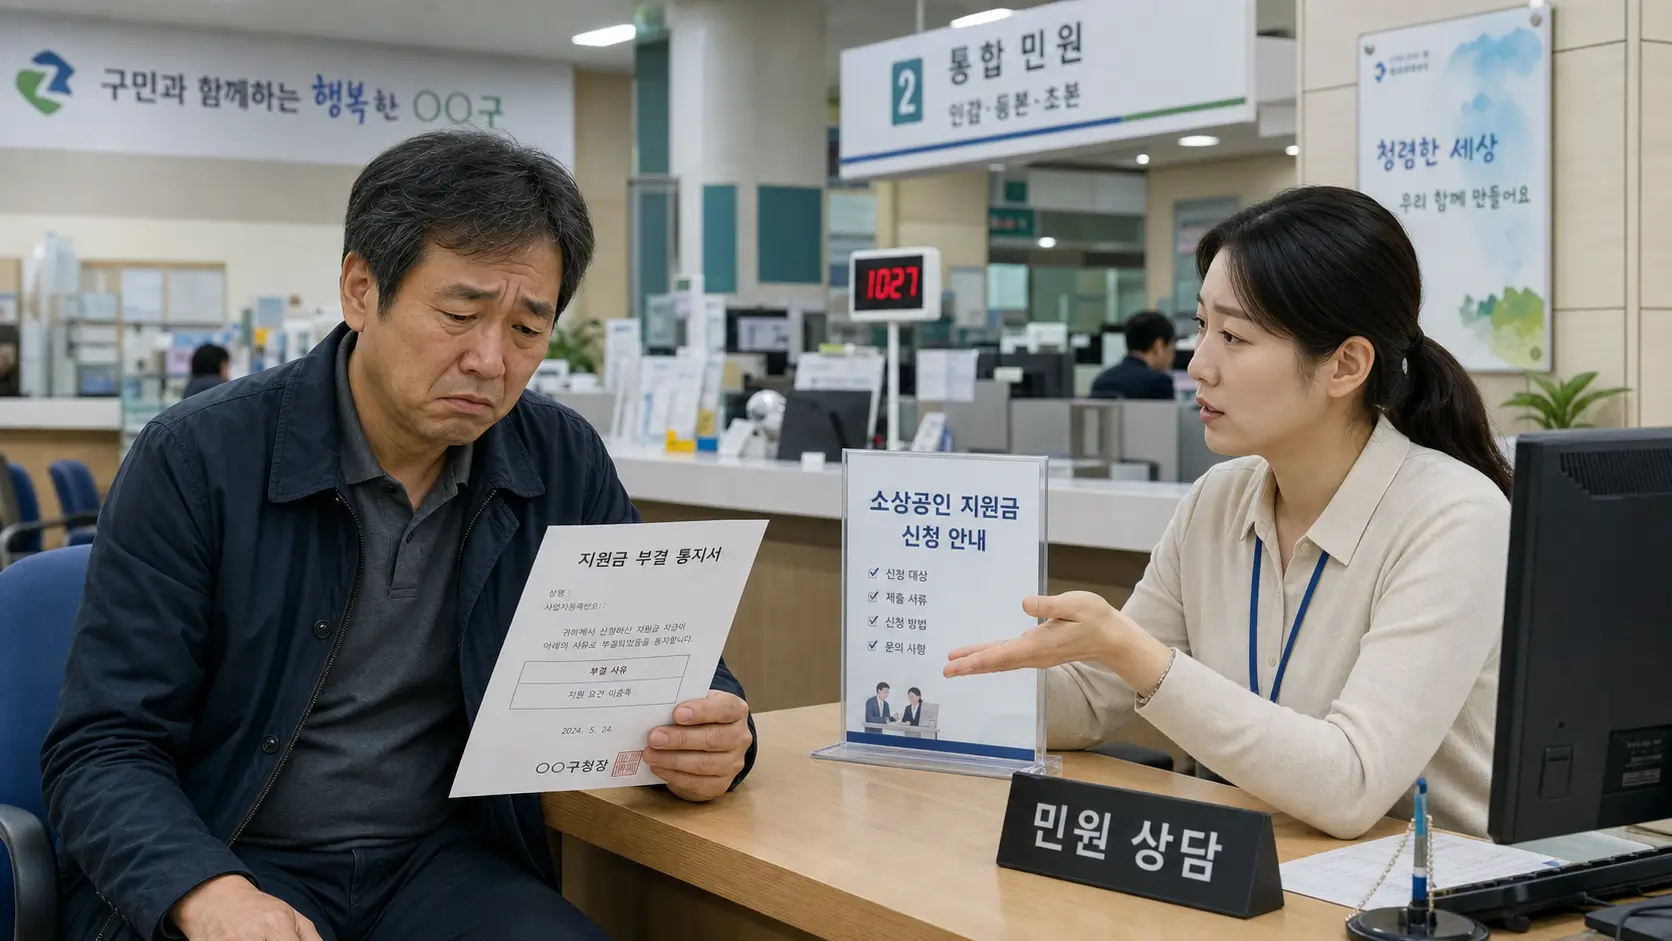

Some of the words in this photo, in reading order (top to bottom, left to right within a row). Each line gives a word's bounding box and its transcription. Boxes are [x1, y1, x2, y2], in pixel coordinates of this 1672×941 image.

[949, 39, 1004, 86] 통합
[1021, 21, 1083, 72] 민원
[101, 68, 186, 106] 구민과
[198, 75, 300, 114] 함께하는
[311, 73, 399, 125] 행복한
[898, 68, 917, 116] 2
[1377, 136, 1440, 172] 청렴한
[1449, 132, 1499, 164] 세상
[1399, 192, 1427, 214] 우리
[866, 265, 919, 300] 1027
[869, 490, 951, 517] 소상공인
[960, 494, 1020, 521] 지원금
[901, 524, 940, 549] 신청
[948, 527, 986, 552] 안내
[578, 551, 628, 568] 지원금
[635, 549, 669, 567] 부결
[675, 546, 723, 565] 통지서
[885, 568, 905, 581] 신청
[908, 569, 928, 583] 대상
[907, 593, 928, 607] 서류
[885, 616, 905, 630] 신청
[907, 618, 927, 631] 방법
[561, 727, 582, 735] 2024.
[588, 726, 597, 734] 5.
[601, 725, 613, 734] 24.
[1033, 802, 1112, 861] 민원
[1130, 820, 1223, 883] 상담
